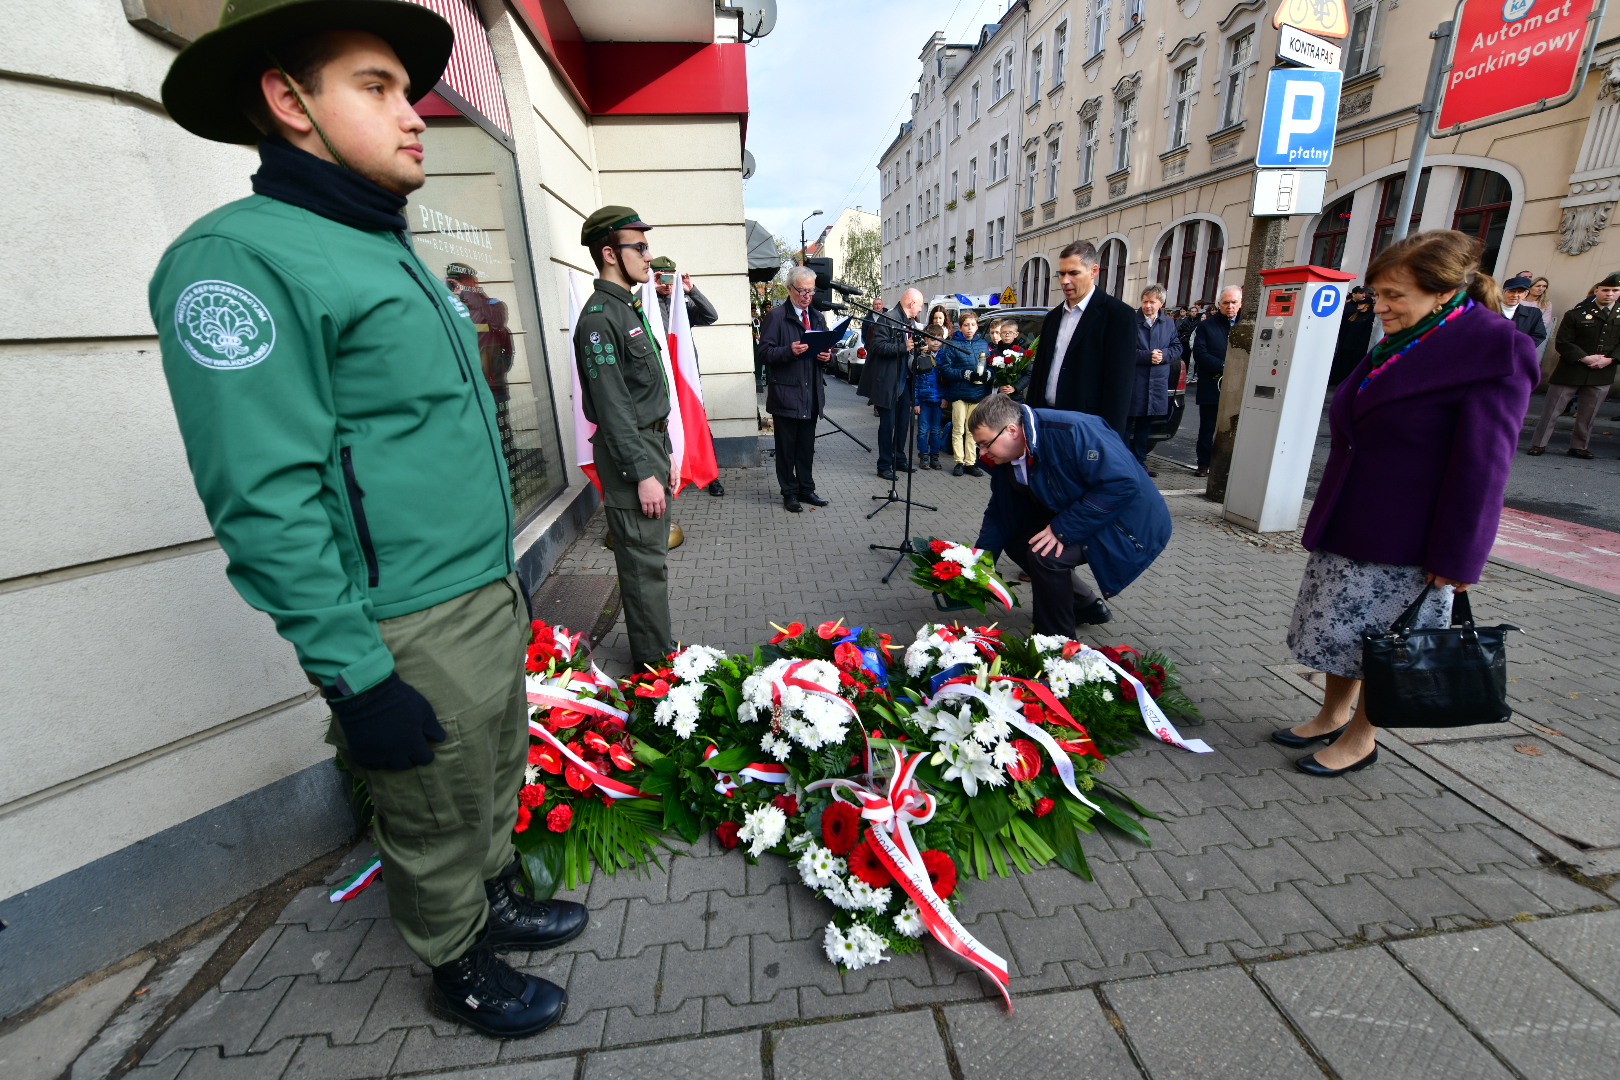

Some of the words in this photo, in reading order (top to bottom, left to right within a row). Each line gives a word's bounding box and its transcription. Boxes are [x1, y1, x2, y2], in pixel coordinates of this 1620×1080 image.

[1470, 0, 1572, 53] Automat
[1289, 37, 1334, 65] KONTRAPAS
[1451, 29, 1580, 90] parkingowy
[1276, 80, 1325, 154] P
[1289, 146, 1329, 162] płatny
[419, 204, 492, 250] PIEKARNIA
[1317, 289, 1336, 312] P
[1143, 704, 1161, 726] NSZZ
